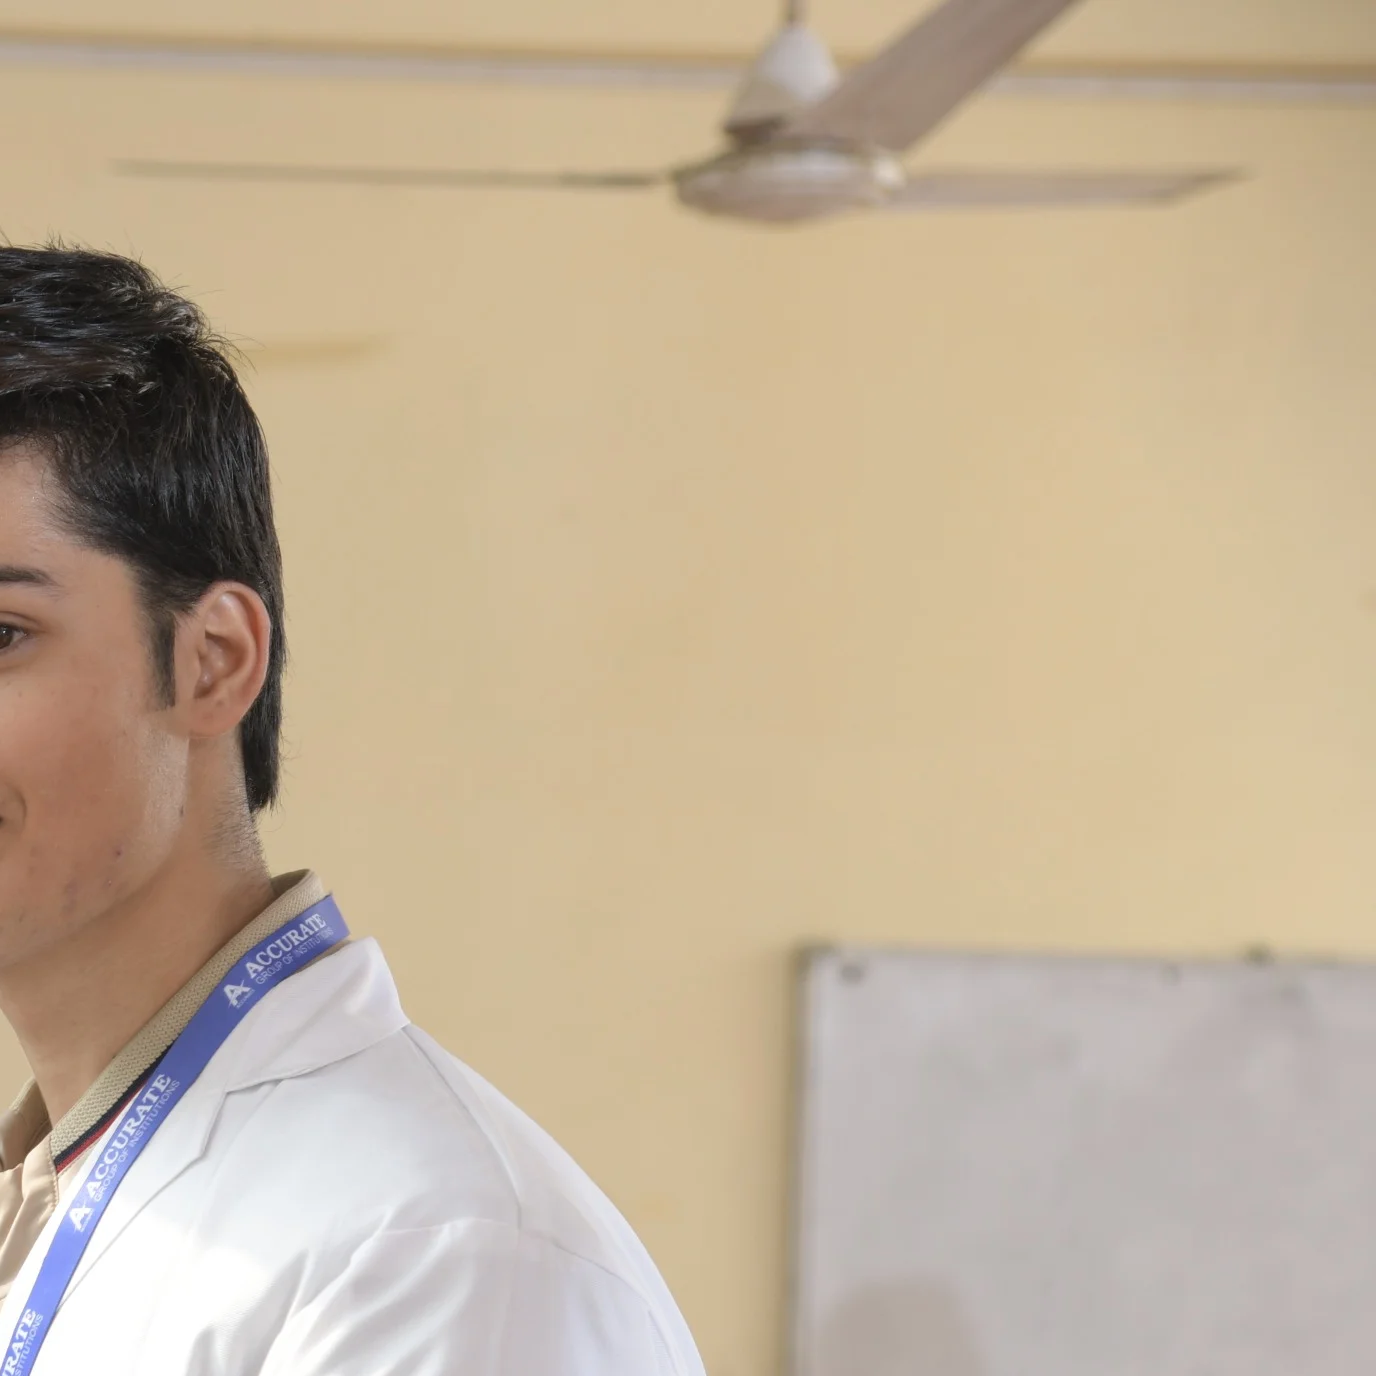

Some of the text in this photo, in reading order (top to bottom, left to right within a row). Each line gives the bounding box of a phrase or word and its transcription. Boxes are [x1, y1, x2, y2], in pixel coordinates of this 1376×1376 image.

[245, 913, 327, 979] ACCURATE
[255, 961, 283, 985] GROUP
[282, 952, 294, 965] OF
[86, 1073, 172, 1199] ACCURATE
[94, 1080, 180, 1202] GROUP OF INSTITUTIONS
